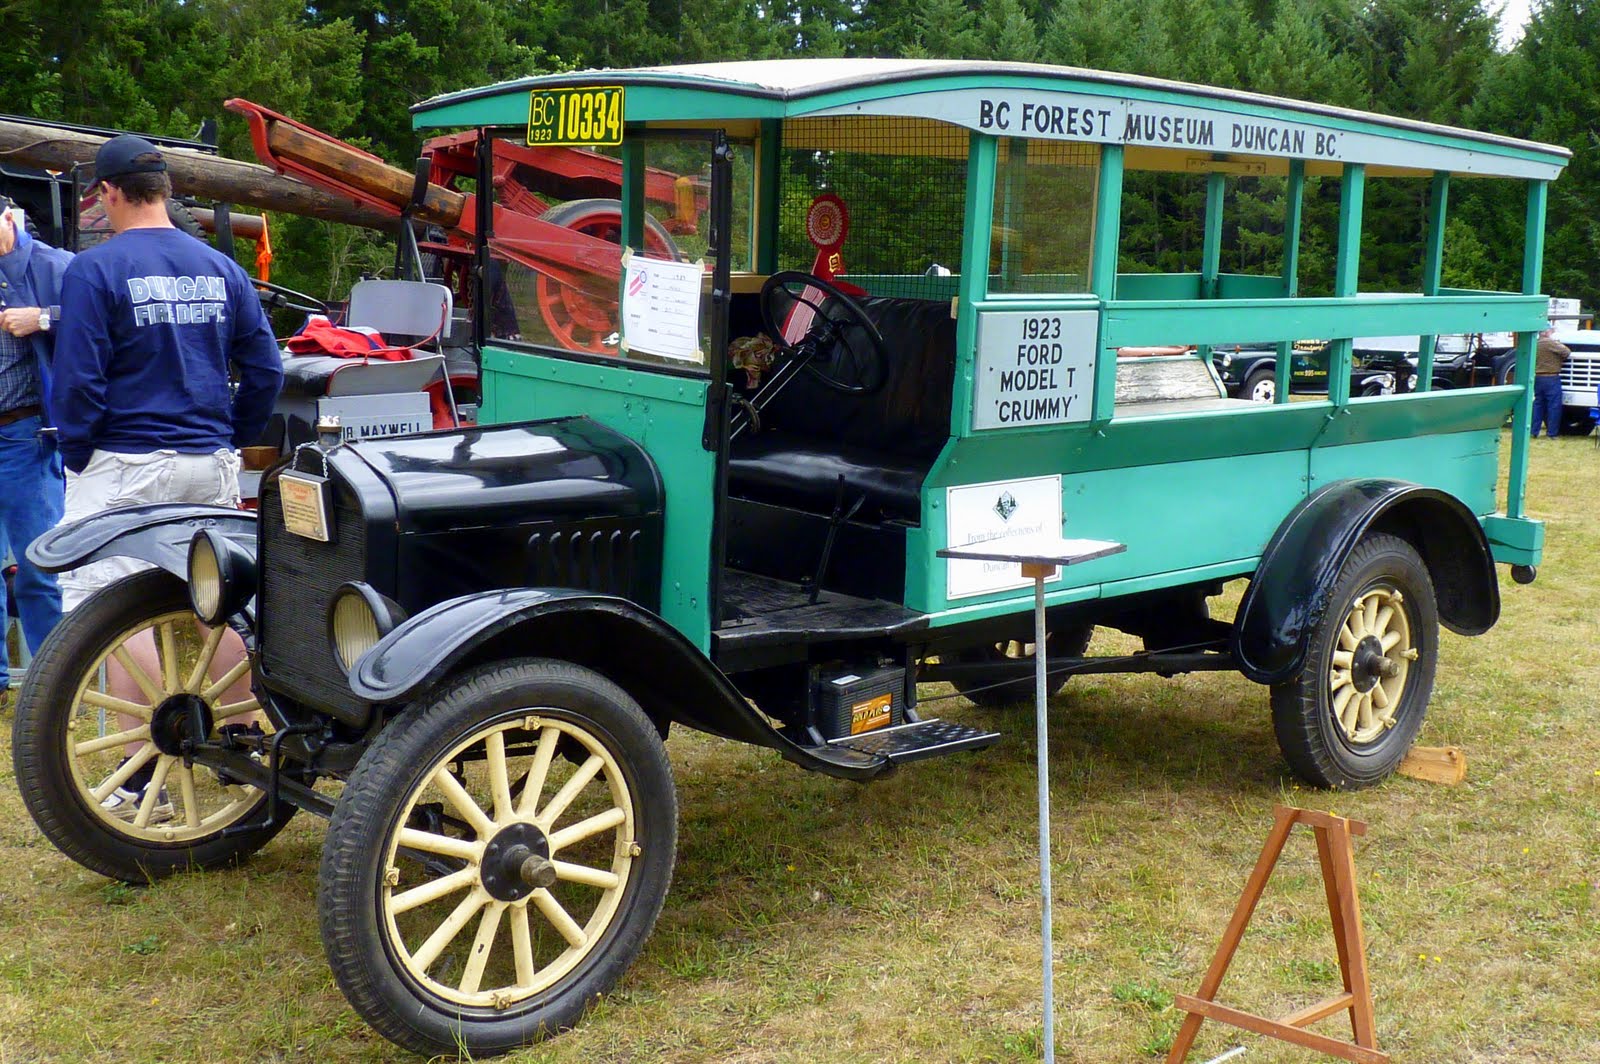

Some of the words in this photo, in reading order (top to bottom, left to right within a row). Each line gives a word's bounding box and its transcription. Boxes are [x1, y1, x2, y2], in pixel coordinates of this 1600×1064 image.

[532, 96, 554, 126] BC
[558, 92, 619, 140] 10334
[979, 99, 1011, 131] BC
[1021, 102, 1111, 137] FOREST
[1123, 113, 1214, 146] MUSEUM
[1232, 123, 1305, 154] DUNCAN
[531, 128, 552, 141] 1923
[127, 275, 227, 304] DUNCAN
[1022, 317, 1062, 340] 1923
[1017, 343, 1063, 366] FORD
[1000, 368, 1058, 393] MODEL
[1067, 367, 1076, 388] T
